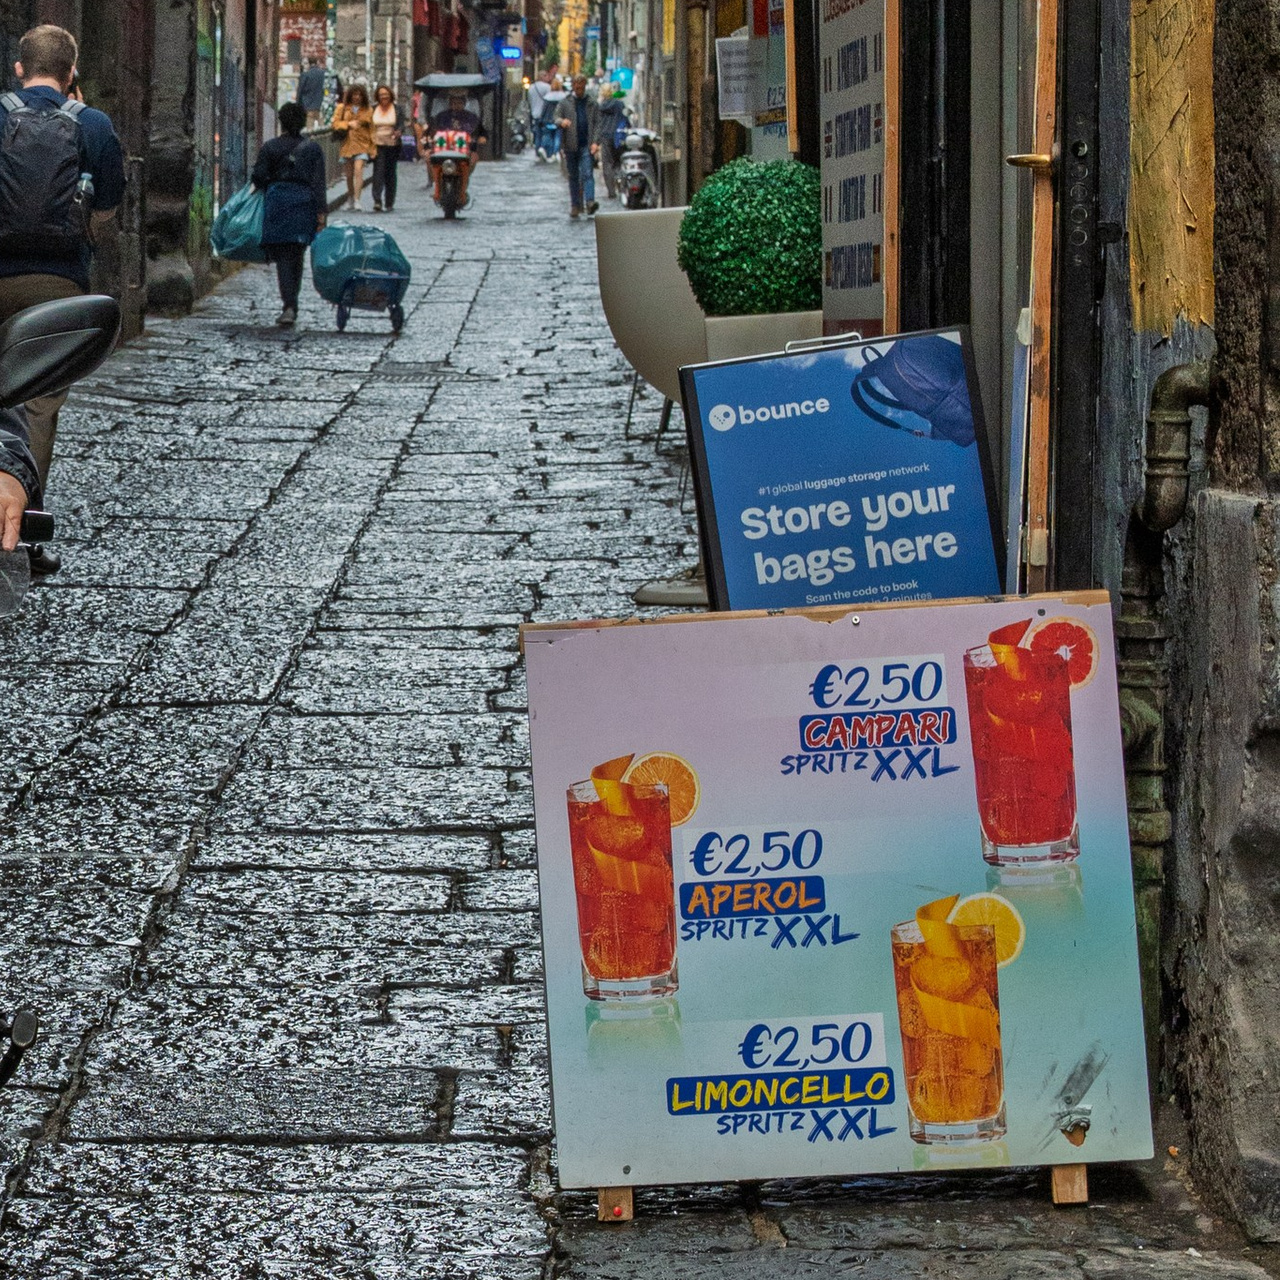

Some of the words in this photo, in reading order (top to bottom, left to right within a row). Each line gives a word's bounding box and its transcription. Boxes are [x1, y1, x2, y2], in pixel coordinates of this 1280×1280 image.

[738, 398, 831, 426] bounce
[758, 485, 771, 496] #1
[772, 480, 804, 498] global
[804, 474, 847, 491] luggage
[848, 469, 888, 487] storage
[888, 462, 930, 478] network
[740, 498, 852, 540] Store
[862, 483, 956, 532] your
[753, 546, 856, 586] bags
[864, 531, 959, 569] here
[805, 593, 832, 605] Scan
[833, 590, 852, 600] the
[852, 585, 879, 597] code
[880, 584, 891, 594] to
[892, 579, 919, 592] book
[807, 660, 944, 711] €2,50
[803, 710, 951, 749] CAMPARI
[780, 750, 870, 777] SPRITZ
[871, 747, 961, 782] XXL
[689, 828, 824, 878] €2,50
[687, 880, 821, 916] APEROL
[680, 917, 770, 942] SPRITZ
[770, 914, 861, 949] XXL
[738, 1021, 873, 1071] €2,50
[671, 1070, 893, 1111] LIMONCELLO
[716, 1110, 806, 1136] SPRITZ
[805, 1106, 898, 1143] XXL
